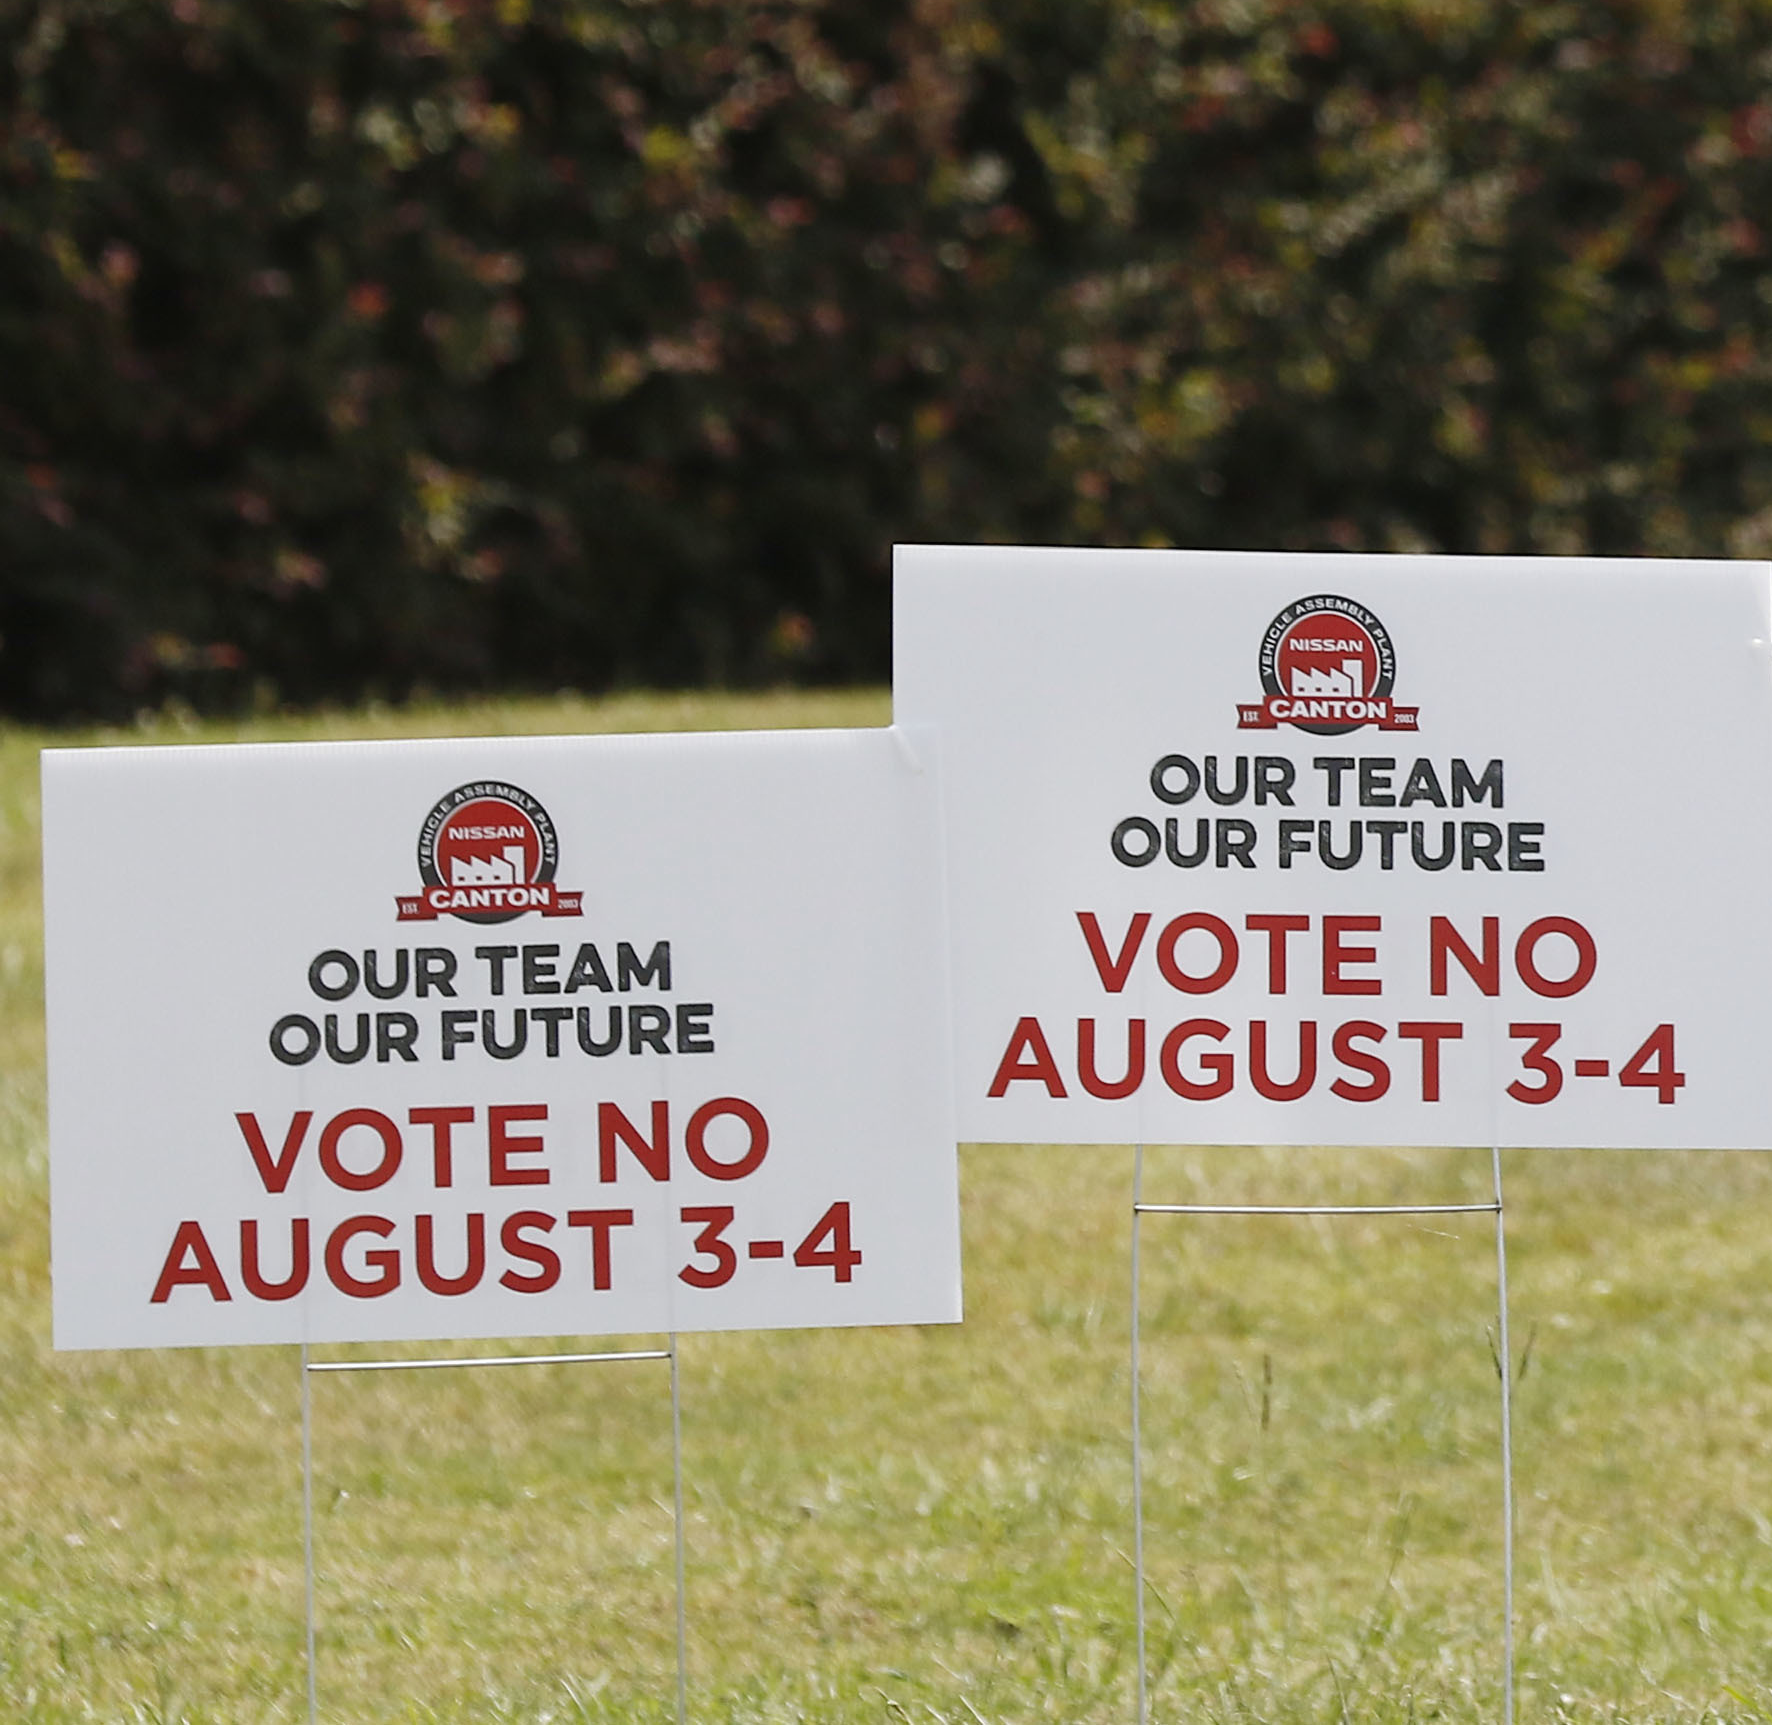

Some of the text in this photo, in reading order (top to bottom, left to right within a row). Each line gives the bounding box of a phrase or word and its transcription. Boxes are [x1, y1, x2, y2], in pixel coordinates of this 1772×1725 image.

[1261, 598, 1392, 680] VEHICLE ASSEMBLY PLANT
[1290, 638, 1364, 652] NISSAN
[1269, 700, 1387, 718] CANTON
[1150, 754, 1503, 808] OUR TEAM
[420, 784, 556, 867] VEHICLE ASSEMBLY PLANT
[448, 826, 525, 840] NISSAN
[1111, 817, 1544, 872] OUR FUTURE
[428, 888, 550, 909] CANTON
[308, 941, 671, 1001] OUR TEAM
[1076, 912, 1597, 998] VOTE NO
[269, 1003, 714, 1066] OUR FUTURE
[987, 1017, 1685, 1104] AUGUST 3-4
[235, 1097, 769, 1193] VOTE NO
[150, 1202, 862, 1303] AUGUST 3-4
